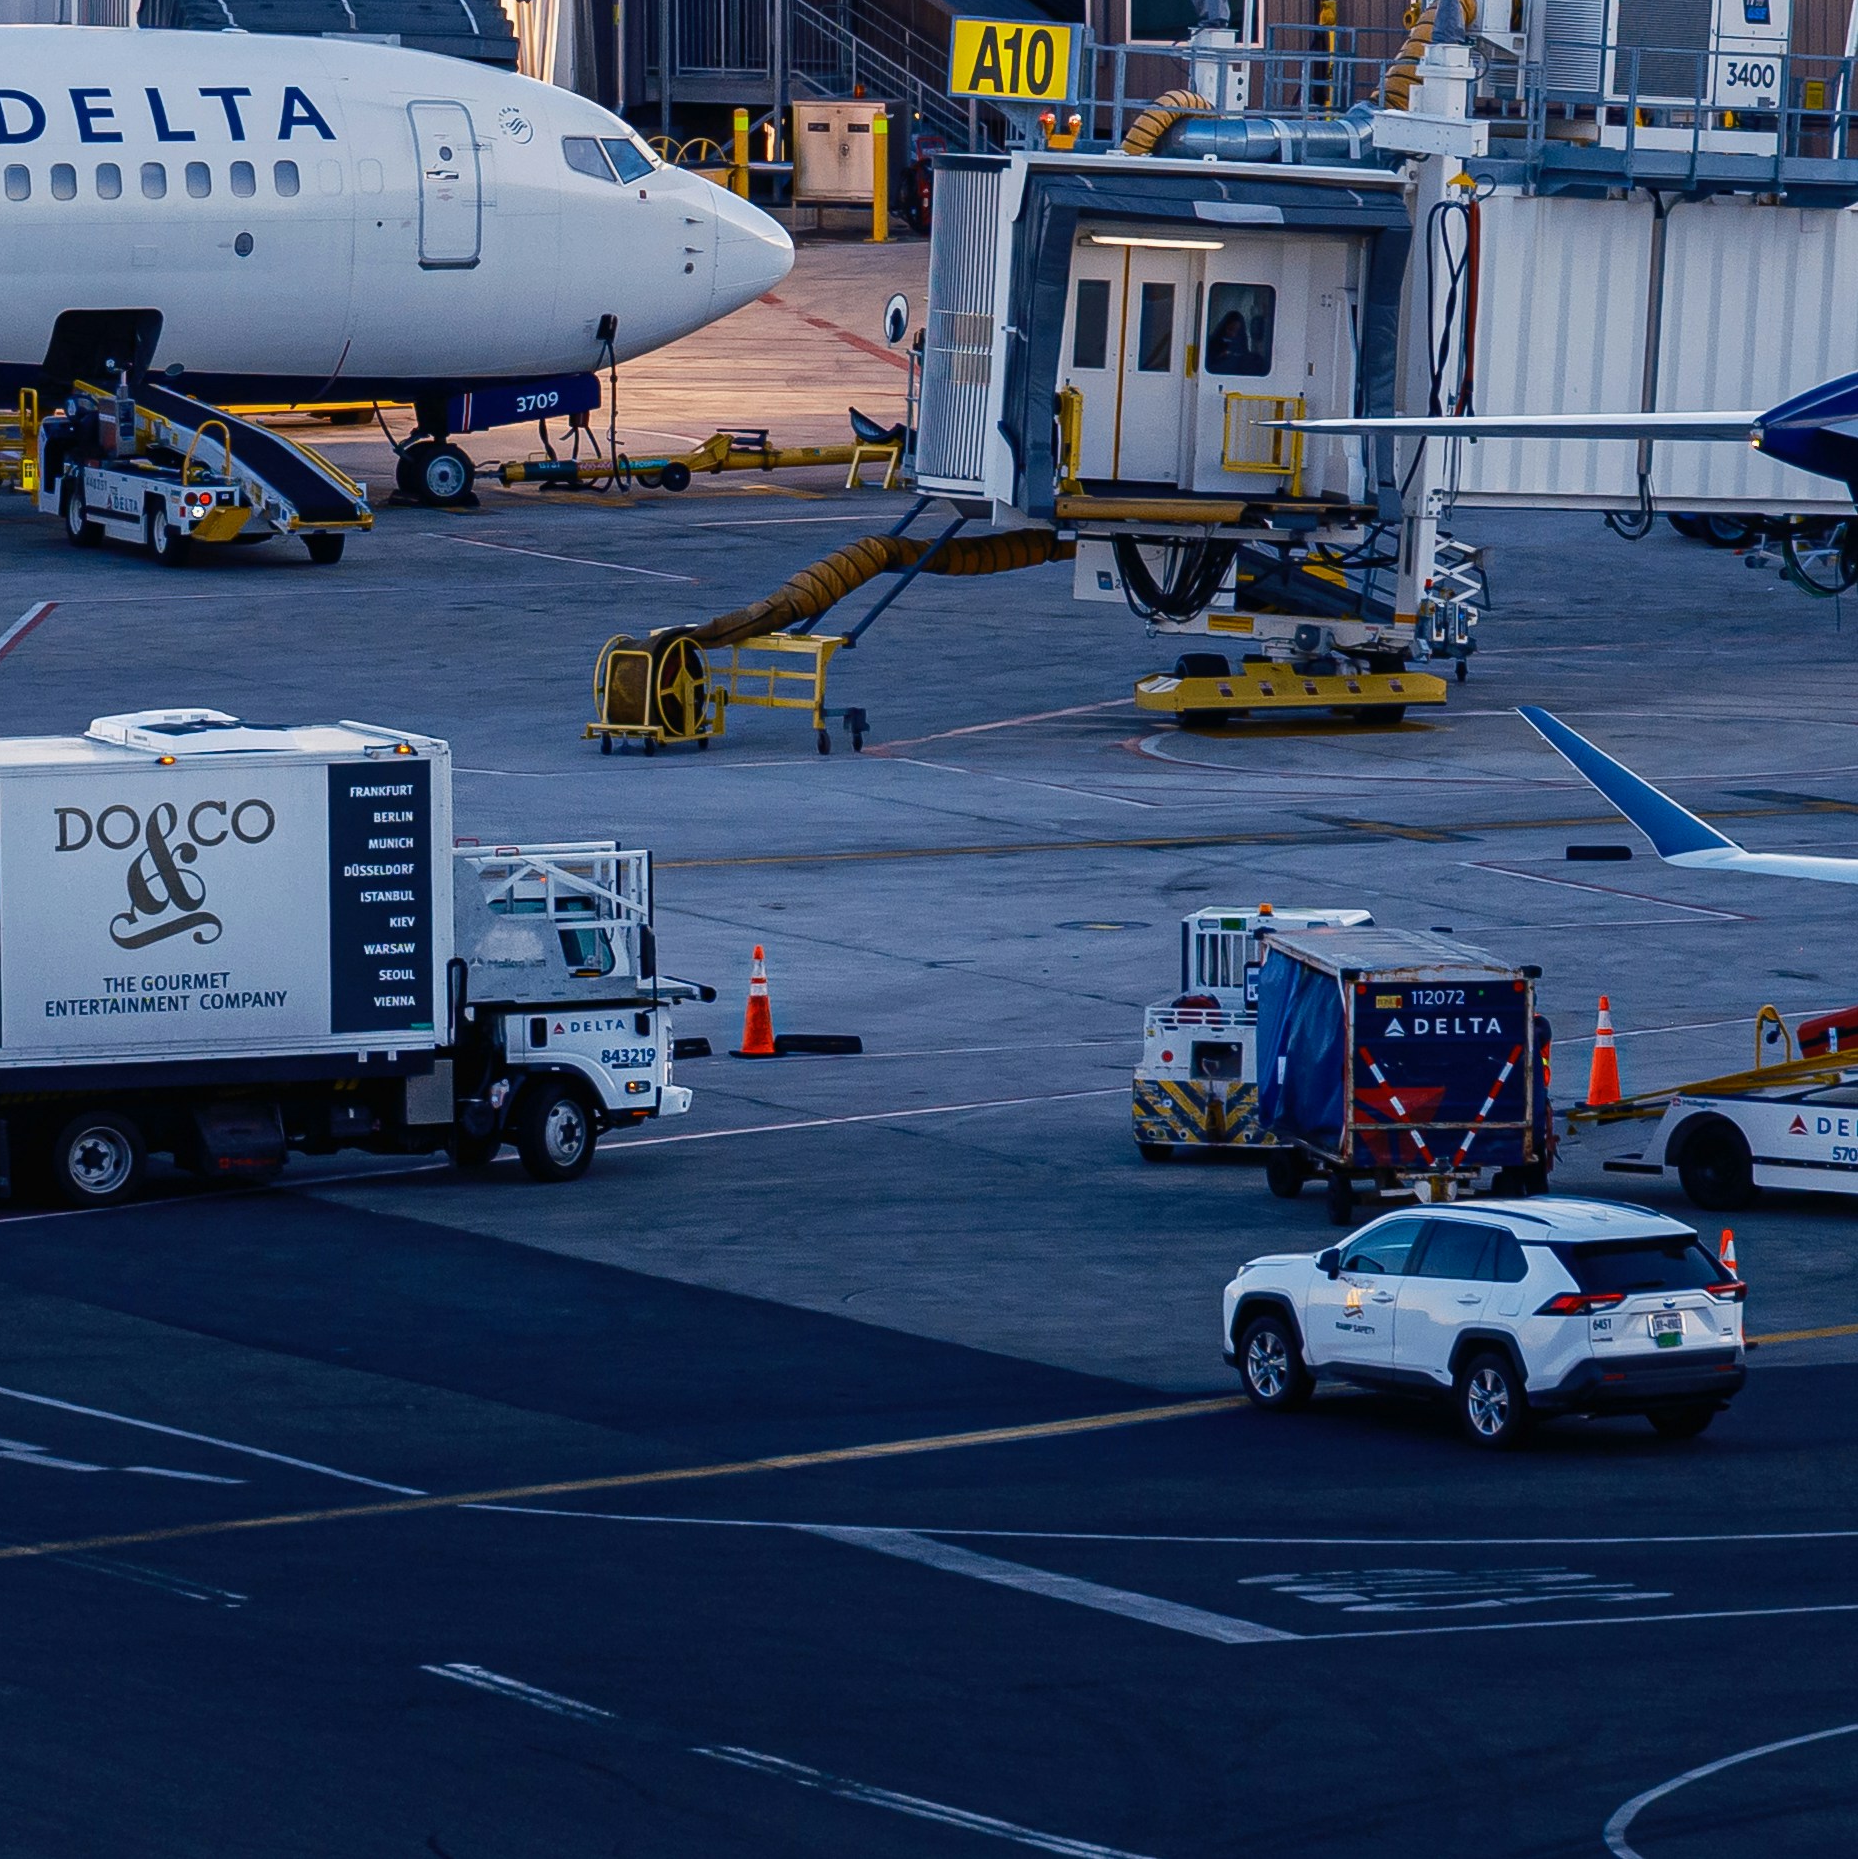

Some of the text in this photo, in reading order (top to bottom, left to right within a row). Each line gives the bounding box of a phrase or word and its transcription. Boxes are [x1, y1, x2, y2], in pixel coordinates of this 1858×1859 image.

[968, 25, 1056, 95] A10
[1725, 60, 1775, 88] 3400
[516, 391, 560, 413] 3709
[113, 496, 139, 512] DELTA
[350, 784, 414, 798] FRANKFURT
[373, 811, 414, 823] BERLIN
[368, 837, 414, 850] MUNICH
[344, 863, 414, 877] DÜSSELDORF
[360, 891, 415, 903] ISTANBUL
[389, 916, 415, 928] KIEV
[364, 943, 415, 956] WARSAW
[103, 971, 231, 994] THE GOURMET
[378, 969, 415, 981] SEOUL
[45, 990, 288, 1017] ENTERTAINMENT COMPANY
[373, 995, 416, 1008] VIENNA
[1412, 990, 1465, 1006] 112072
[570, 1019, 627, 1033] DELTA
[1414, 1018, 1502, 1035] DELTA
[601, 1047, 657, 1065] 843219
[1816, 1117, 1858, 1138] DE
[1831, 1146, 1858, 1162] 570
